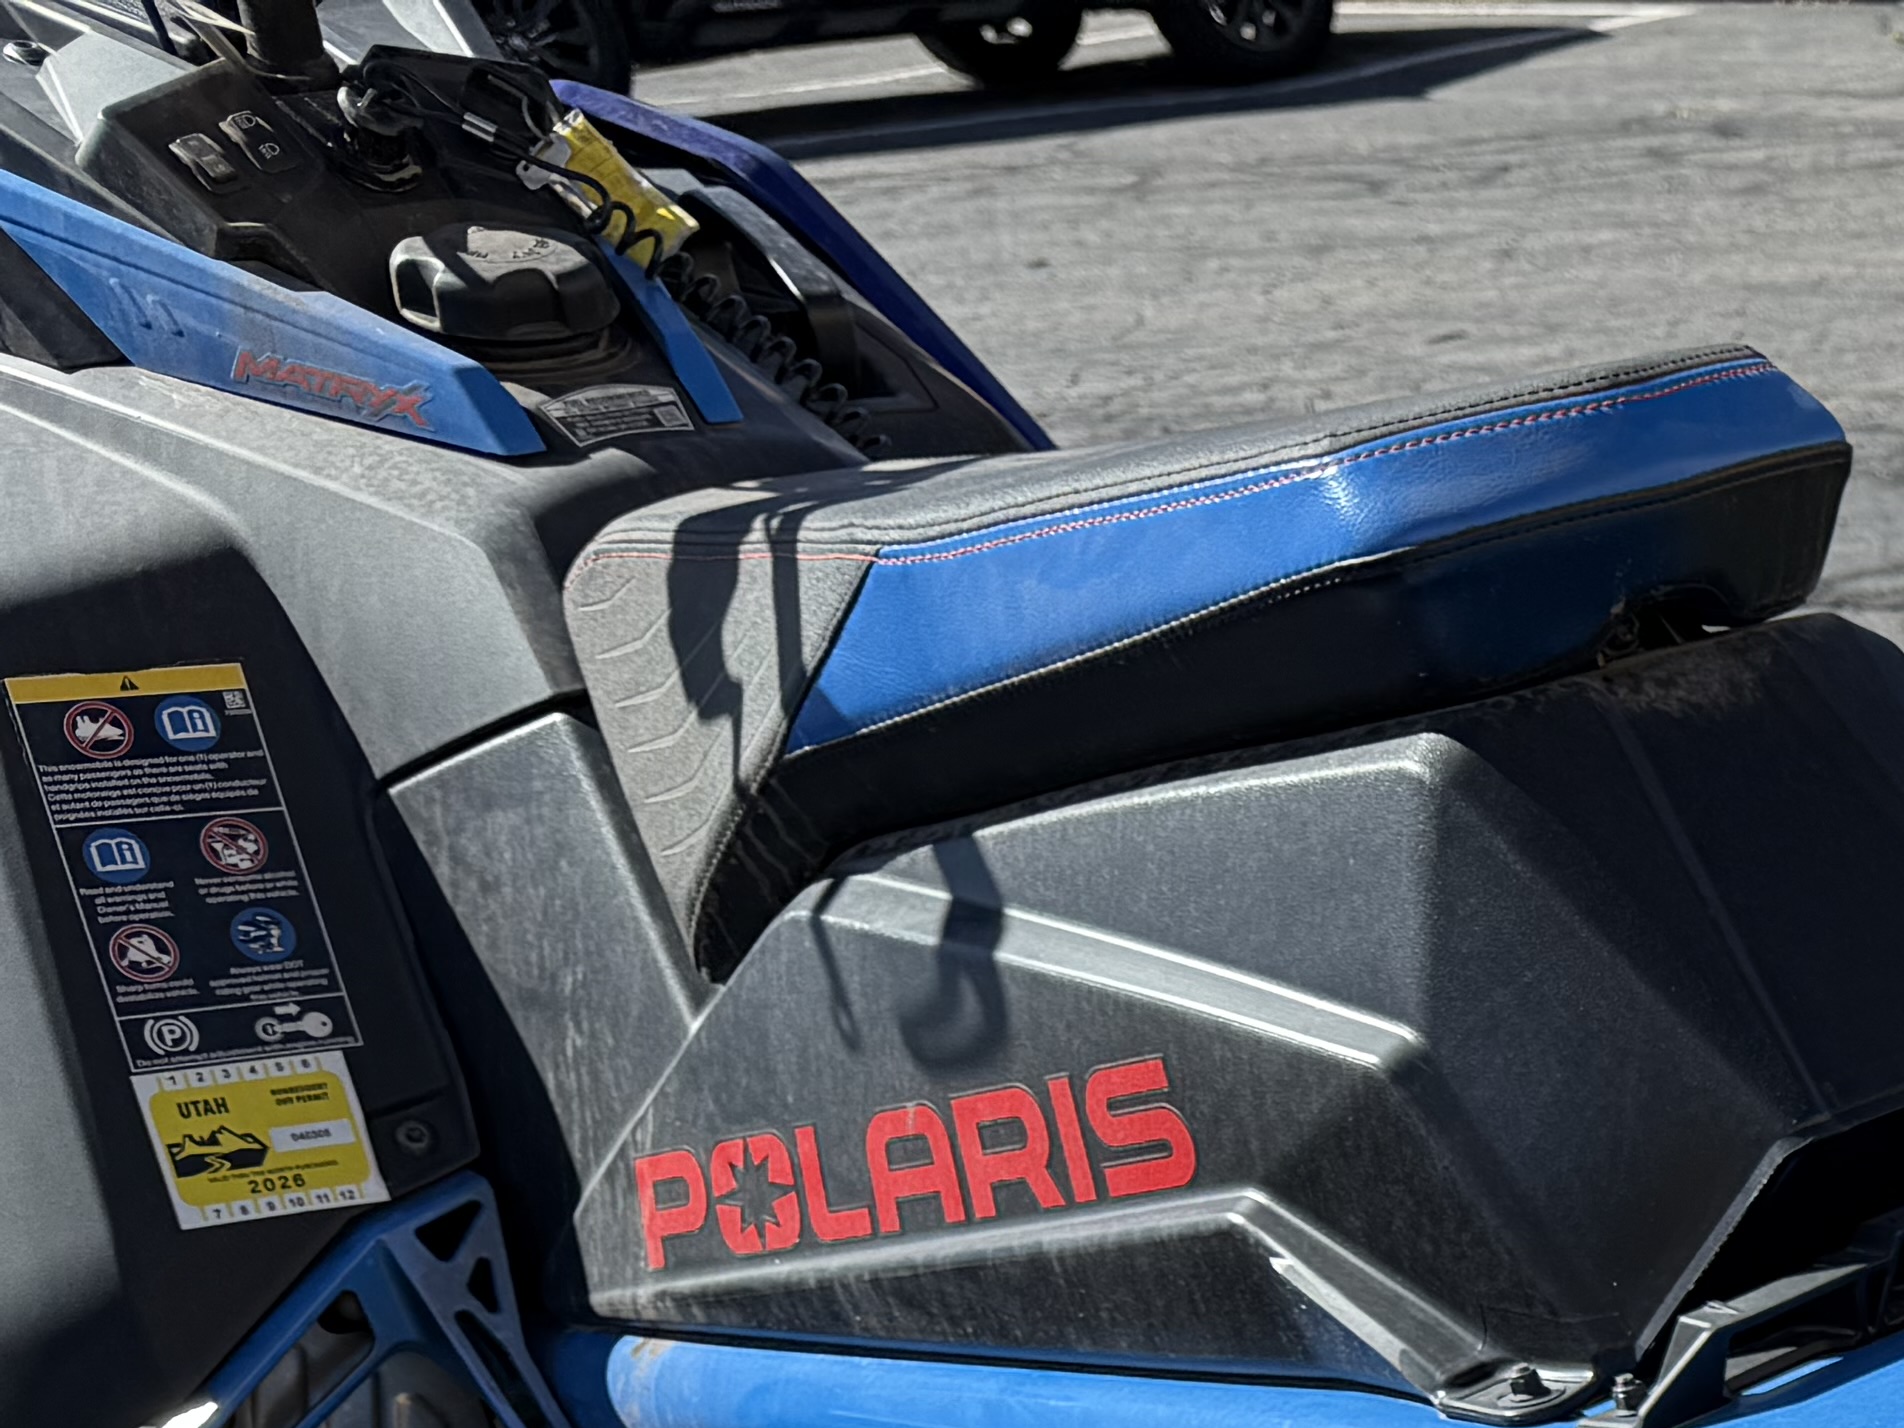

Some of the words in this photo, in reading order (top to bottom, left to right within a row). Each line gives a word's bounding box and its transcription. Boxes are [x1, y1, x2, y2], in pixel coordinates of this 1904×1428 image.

[231, 350, 434, 431] MATRYX
[169, 1075, 177, 1086] 1
[196, 1071, 205, 1083] 2
[222, 1068, 232, 1079] 3
[249, 1064, 258, 1075] 4
[275, 1061, 284, 1073] 5
[301, 1058, 311, 1069] 6
[176, 1097, 230, 1120] UTAH
[634, 1053, 1196, 1270] POLARIS
[248, 1173, 306, 1194] 2026
[213, 1208, 222, 1219] 7
[240, 1205, 250, 1217] 8
[267, 1200, 276, 1212] 9
[289, 1196, 305, 1208] 10
[316, 1193, 331, 1204] 11
[339, 1190, 355, 1201] 12
